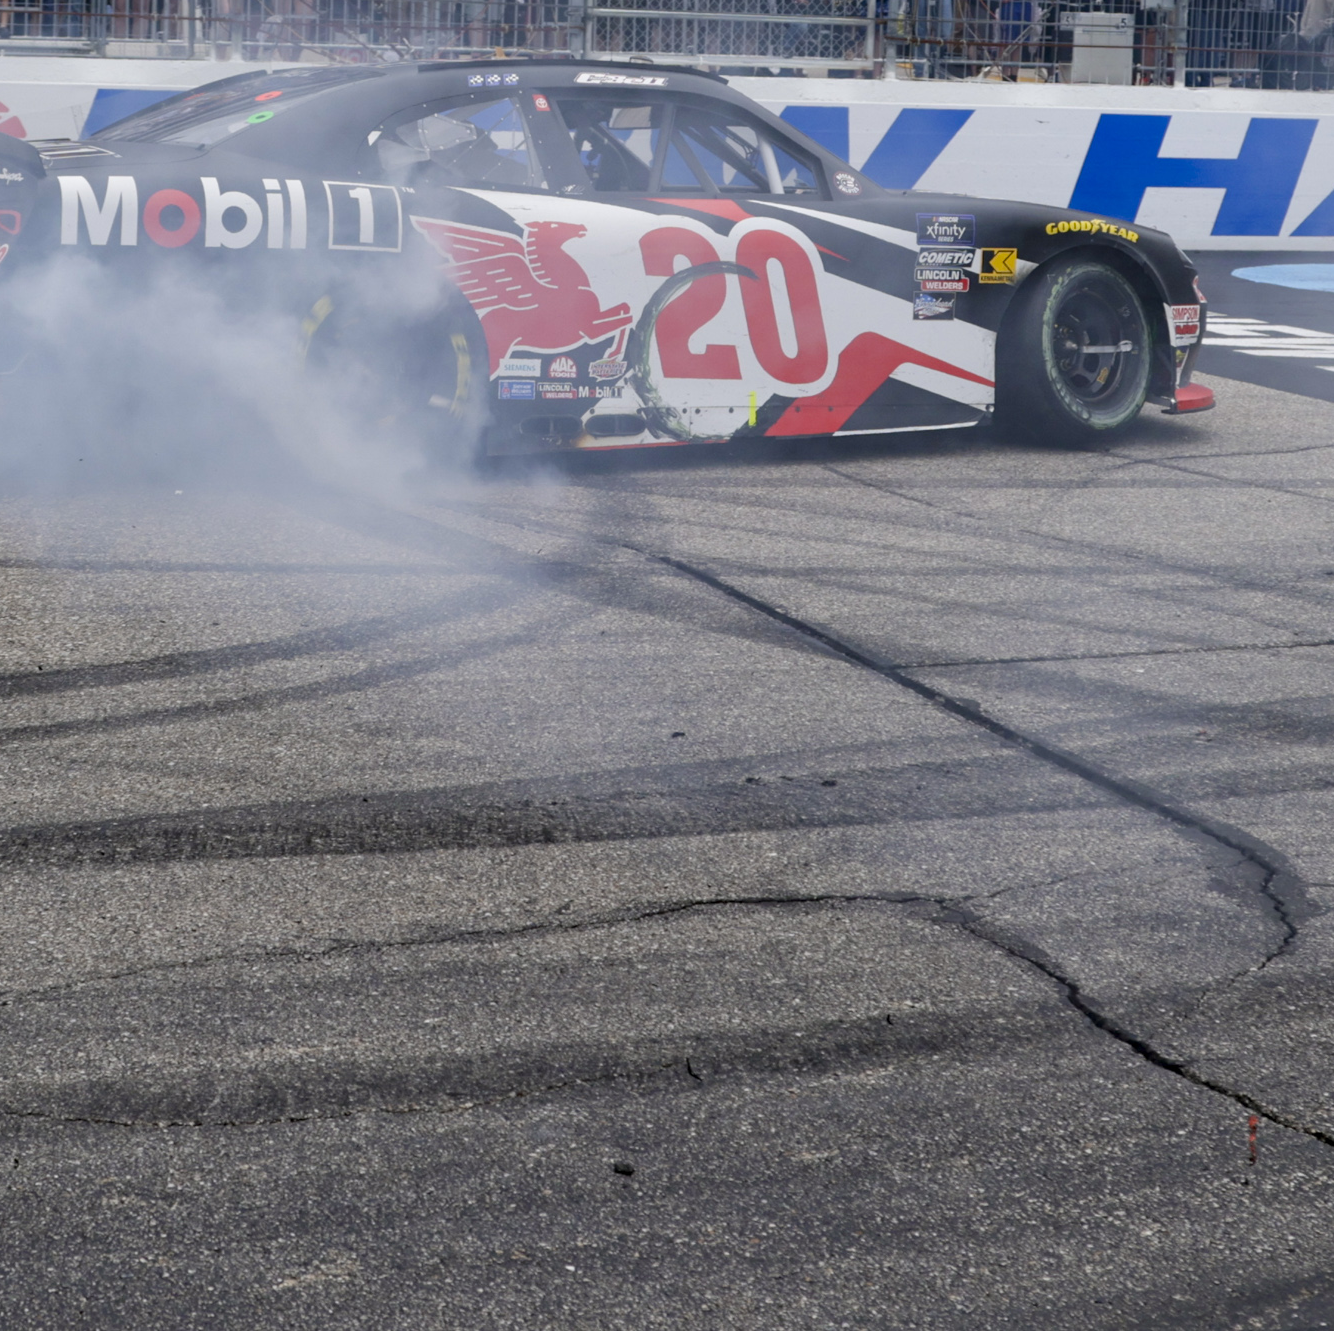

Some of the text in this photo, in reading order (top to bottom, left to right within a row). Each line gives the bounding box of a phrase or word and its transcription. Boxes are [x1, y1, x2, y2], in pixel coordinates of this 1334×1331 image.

[58, 175, 307, 250] Mobil
[926, 222, 966, 239] xfinity
[1045, 219, 1139, 243] GOODYEAR
[918, 251, 974, 265] COMETIC
[917, 270, 960, 280] LINCOLN
[926, 281, 964, 290] WELDERS
[641, 228, 827, 384] 20
[1172, 307, 1199, 321] SIMPSON
[551, 357, 576, 371] MAC
[539, 384, 571, 392] LINCOLN
[578, 385, 610, 398] Mobil
